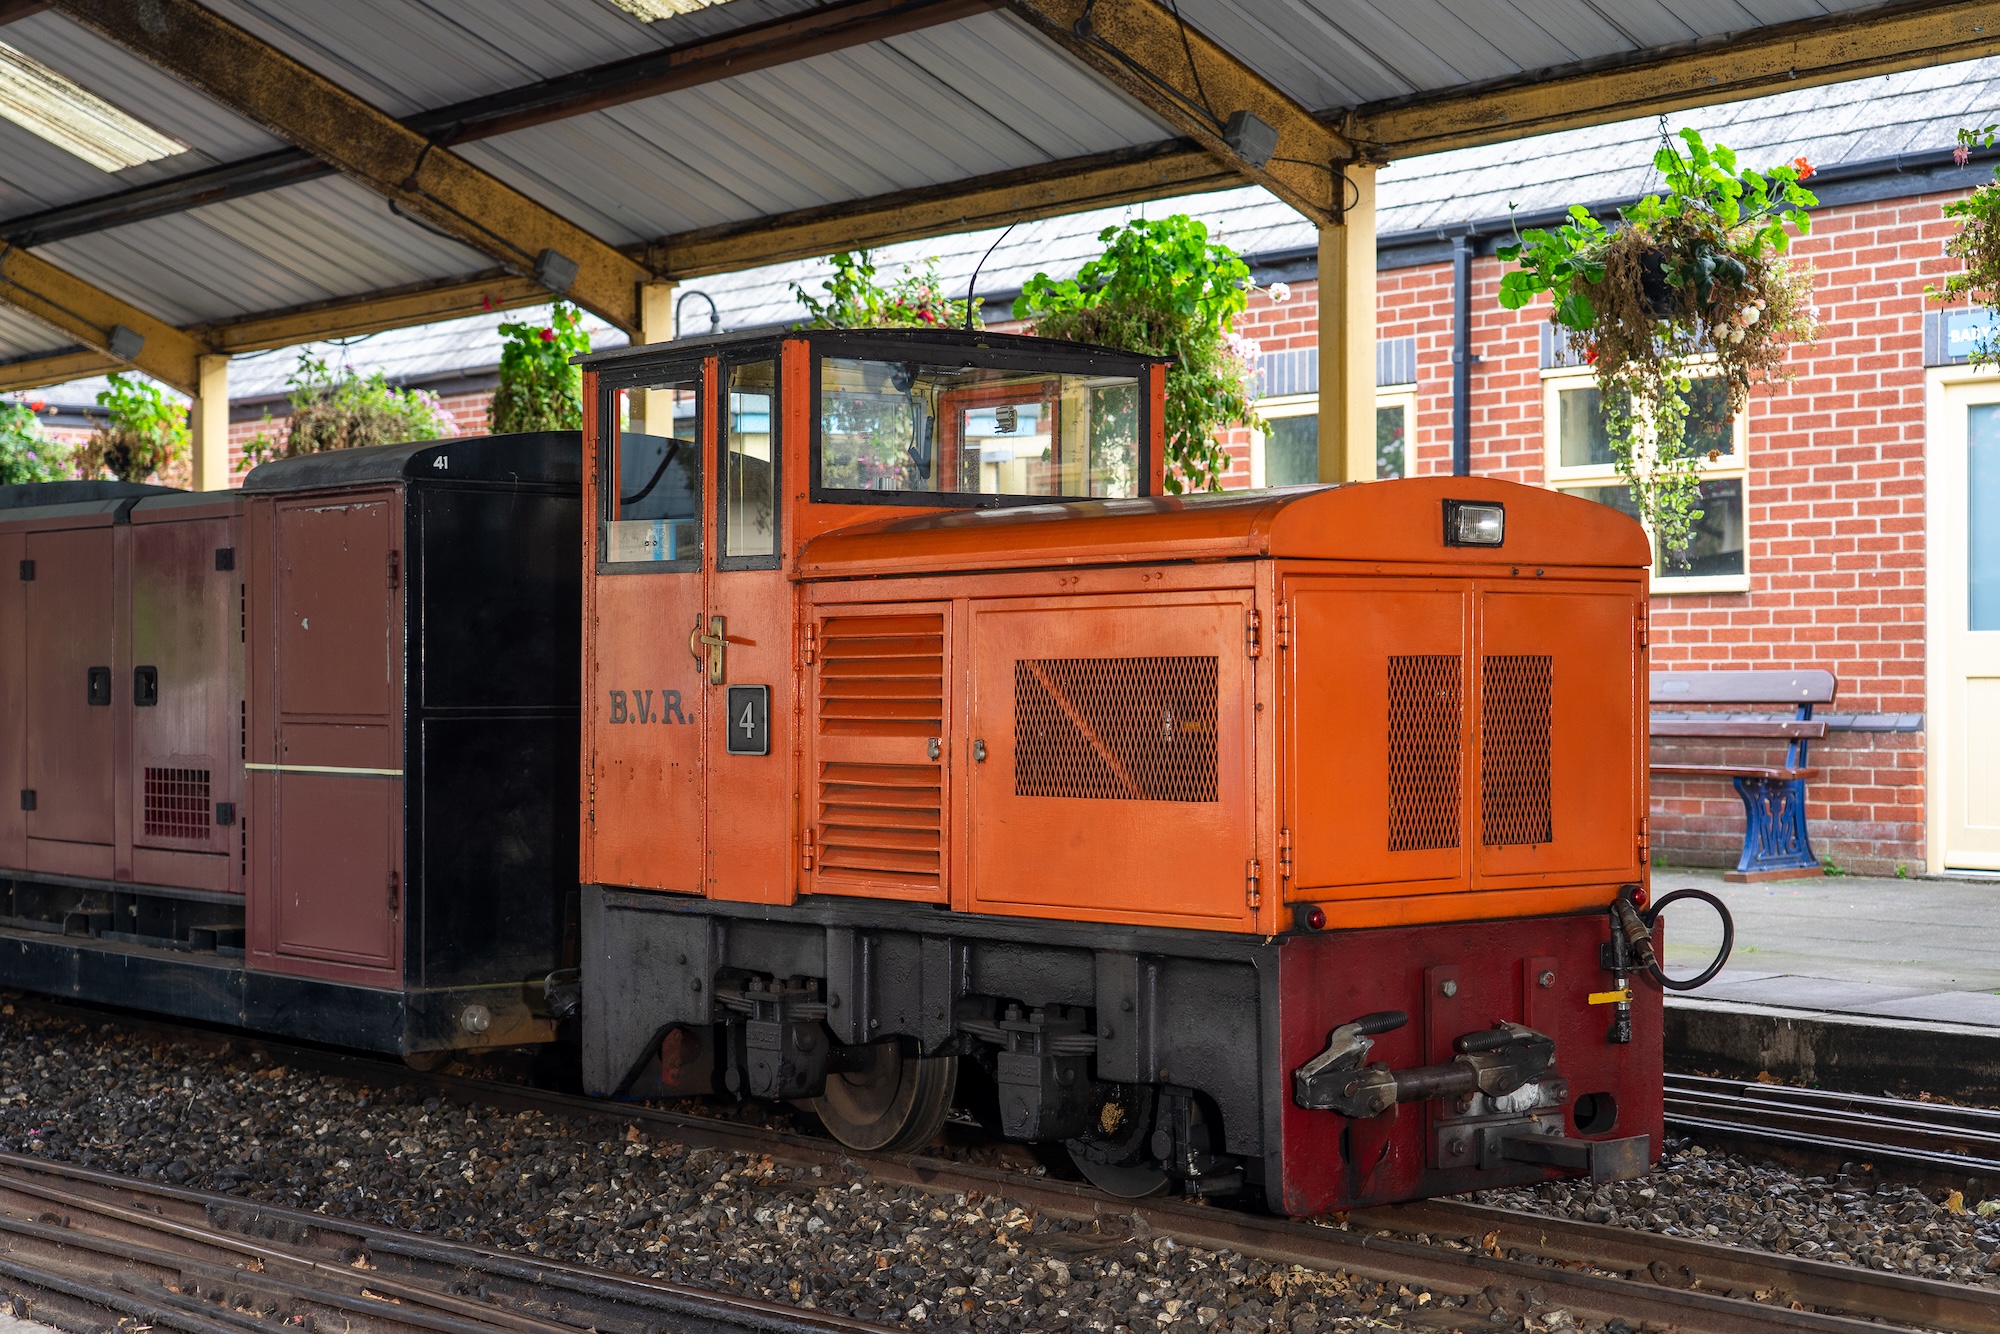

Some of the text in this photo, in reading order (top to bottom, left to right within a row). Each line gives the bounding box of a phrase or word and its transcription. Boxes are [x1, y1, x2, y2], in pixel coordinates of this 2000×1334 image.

[433, 455, 448, 469] 41
[608, 689, 695, 724] B.V.R.
[738, 701, 756, 739] 4
